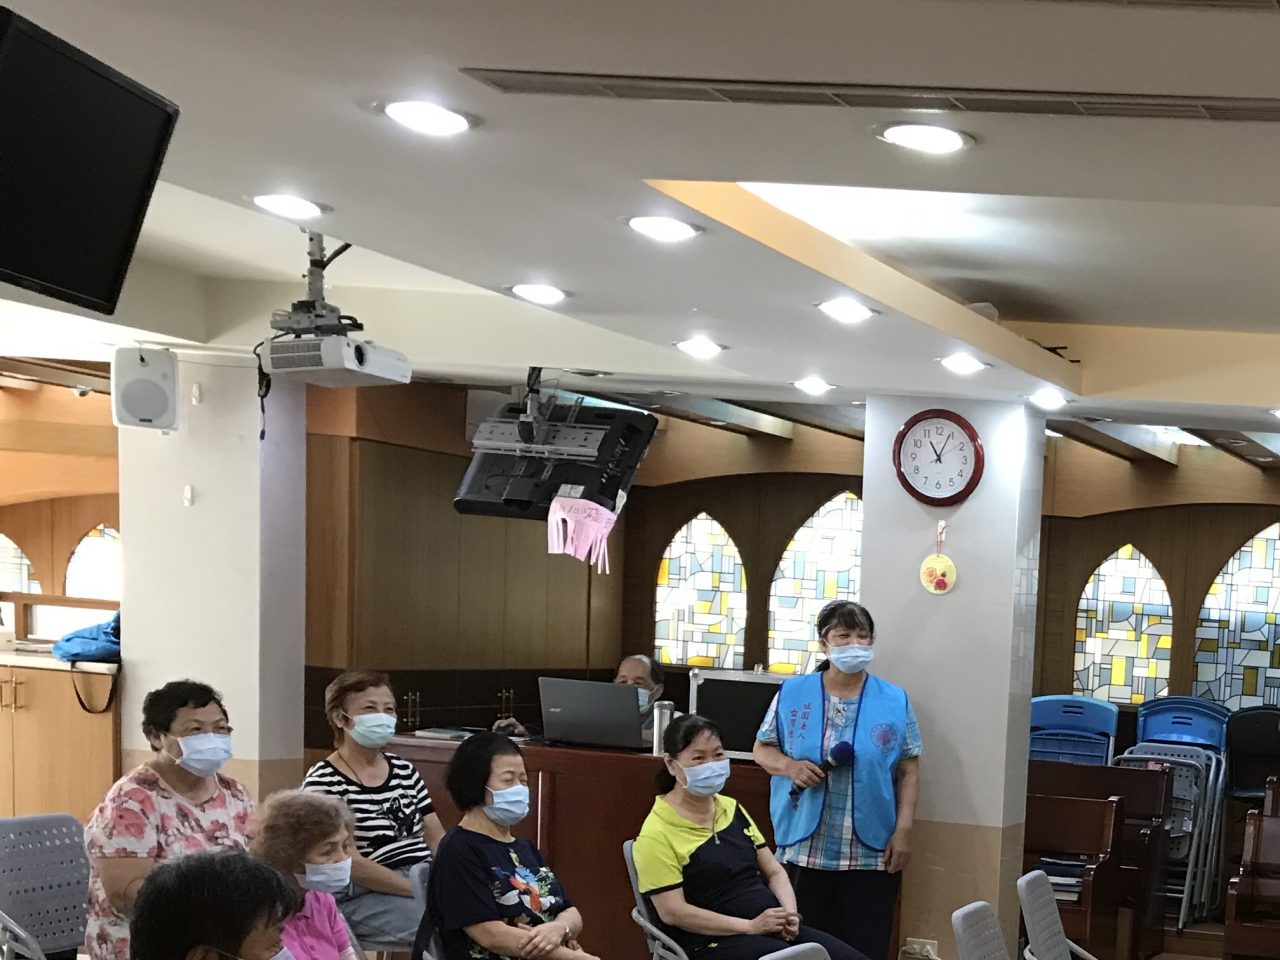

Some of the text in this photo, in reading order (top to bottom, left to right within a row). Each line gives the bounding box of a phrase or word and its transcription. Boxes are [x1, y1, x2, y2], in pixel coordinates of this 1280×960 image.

[923, 429, 931, 439] 11
[935, 426, 944, 436] 12
[950, 431, 955, 440] 1
[913, 439, 922, 449] 10
[958, 442, 966, 452] 2
[910, 453, 917, 462] 9
[961, 456, 968, 465] 3
[913, 465, 920, 475] 8
[957, 469, 963, 478] 4
[922, 477, 929, 486] 7
[935, 480, 942, 490] 6
[948, 478, 955, 487] 5
